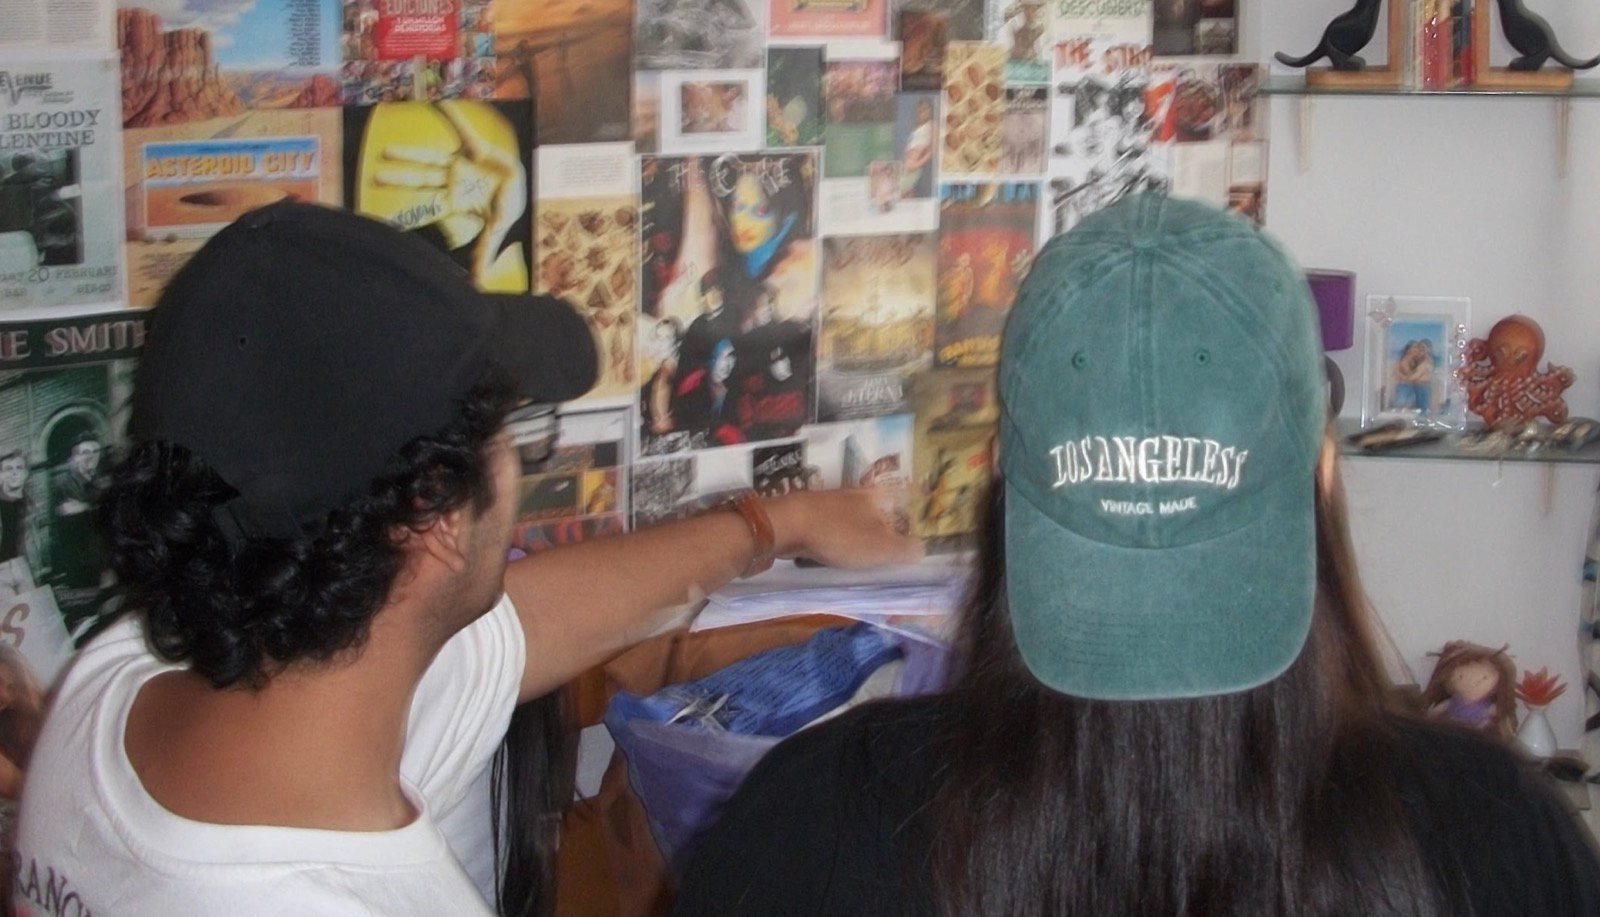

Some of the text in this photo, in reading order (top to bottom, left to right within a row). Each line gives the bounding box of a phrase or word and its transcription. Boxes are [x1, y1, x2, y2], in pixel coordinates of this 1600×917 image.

[8, 109, 102, 130] BLOODY
[0, 129, 96, 150] LENTINE
[146, 151, 315, 178] ASTEROID CITY
[28, 266, 50, 283] 20
[1101, 496, 1197, 514] VINTAGE MADE
